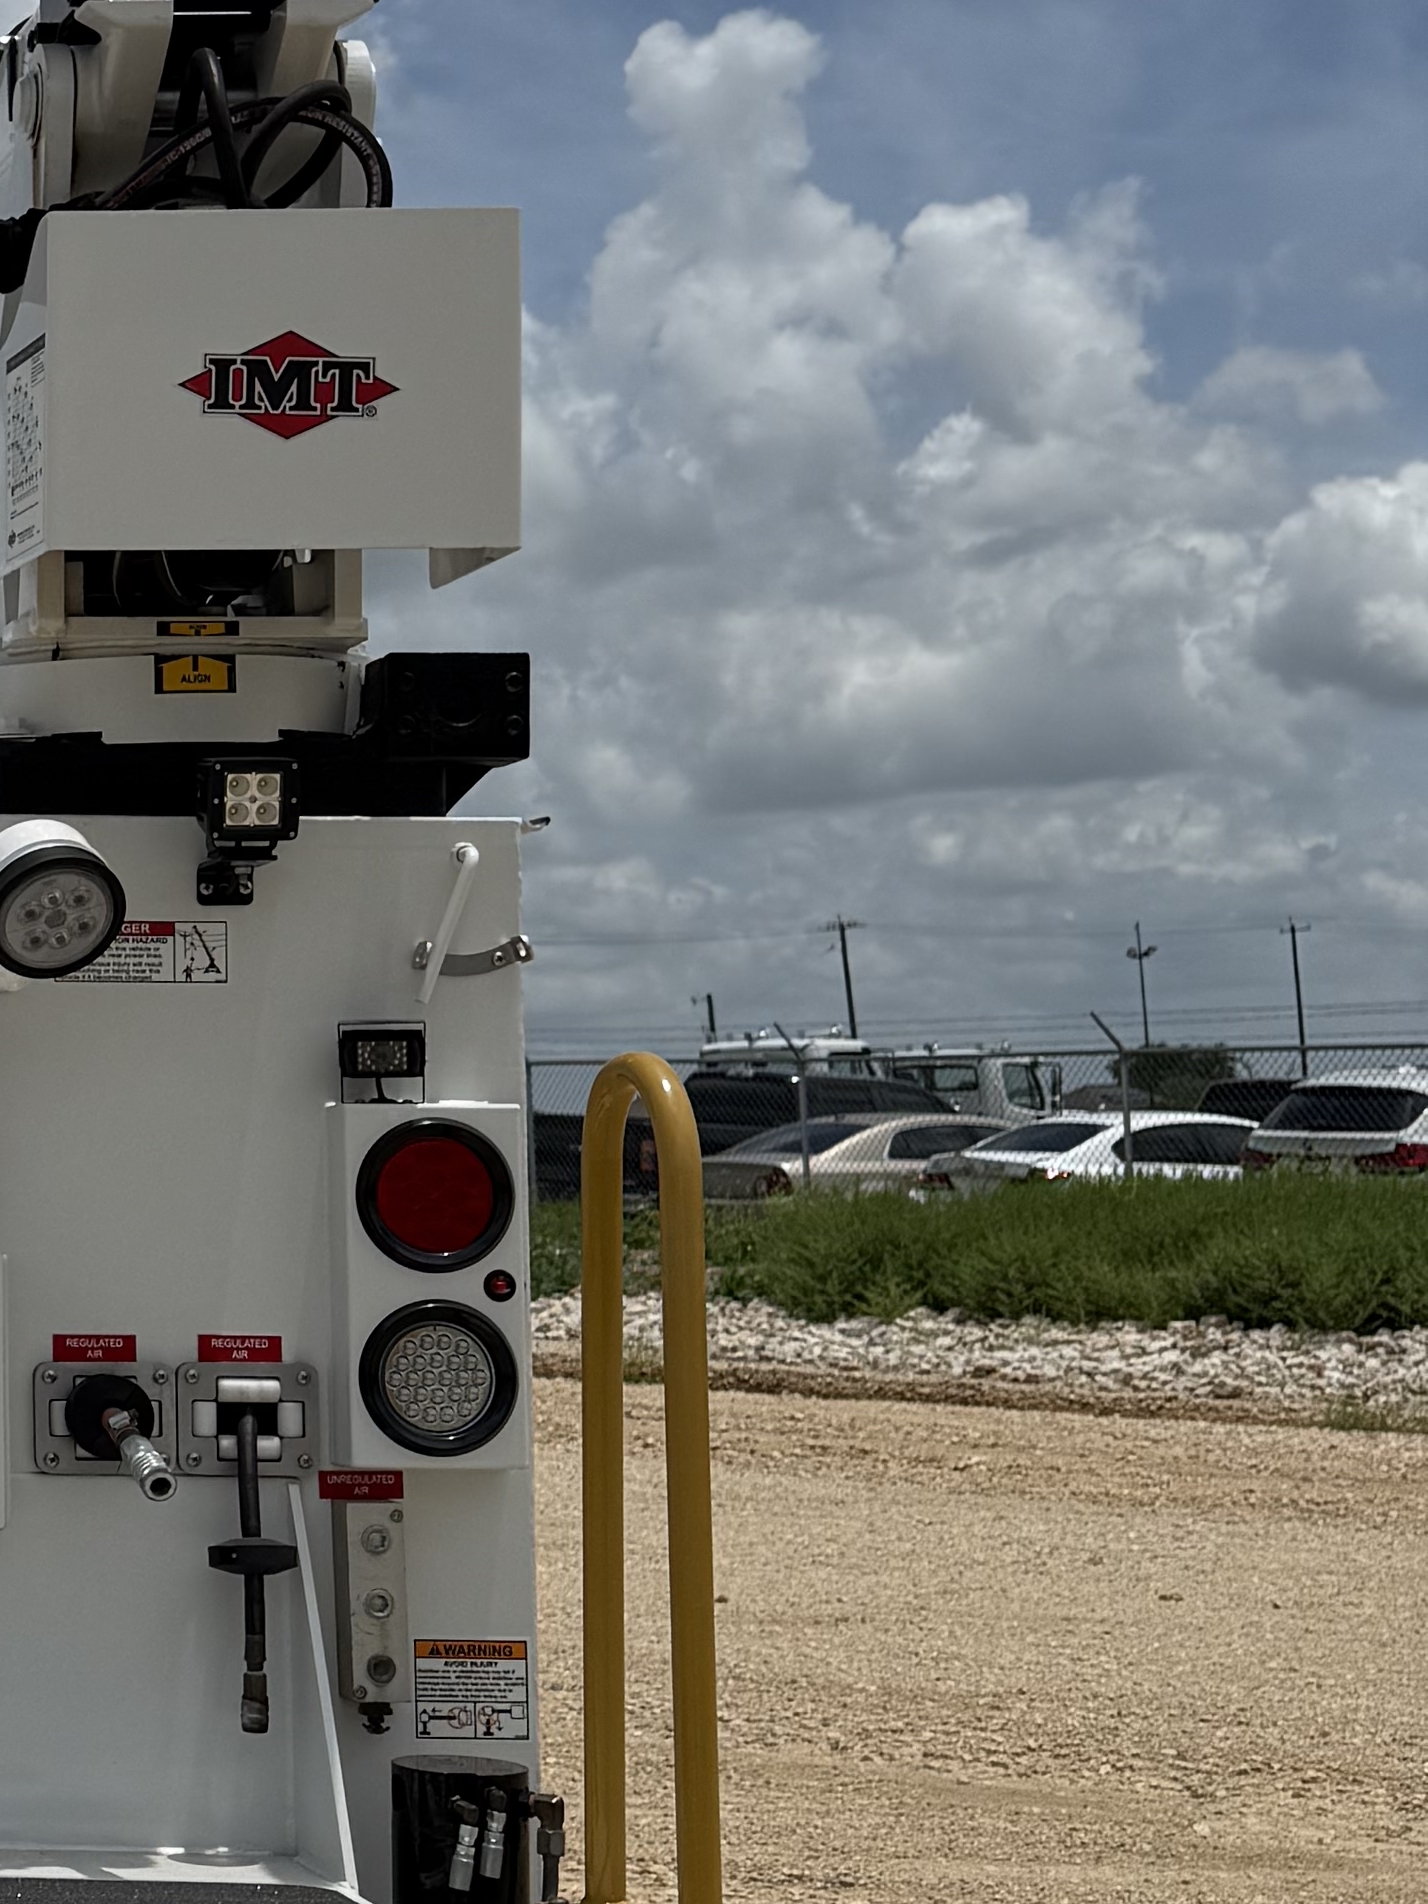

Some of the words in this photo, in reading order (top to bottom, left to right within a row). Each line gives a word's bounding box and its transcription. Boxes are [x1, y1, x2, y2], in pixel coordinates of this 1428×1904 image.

[204, 353, 376, 417] IMT
[180, 673, 211, 684] ALIGN
[121, 923, 151, 934] GER
[66, 1338, 124, 1348] REGULATED
[211, 1338, 269, 1348] REGULATED
[86, 1350, 103, 1359] AIR
[232, 1350, 249, 1359] AIR
[327, 1474, 395, 1484] UNREGULATED
[353, 1486, 369, 1495] AIR
[443, 1644, 513, 1656] WARNING
